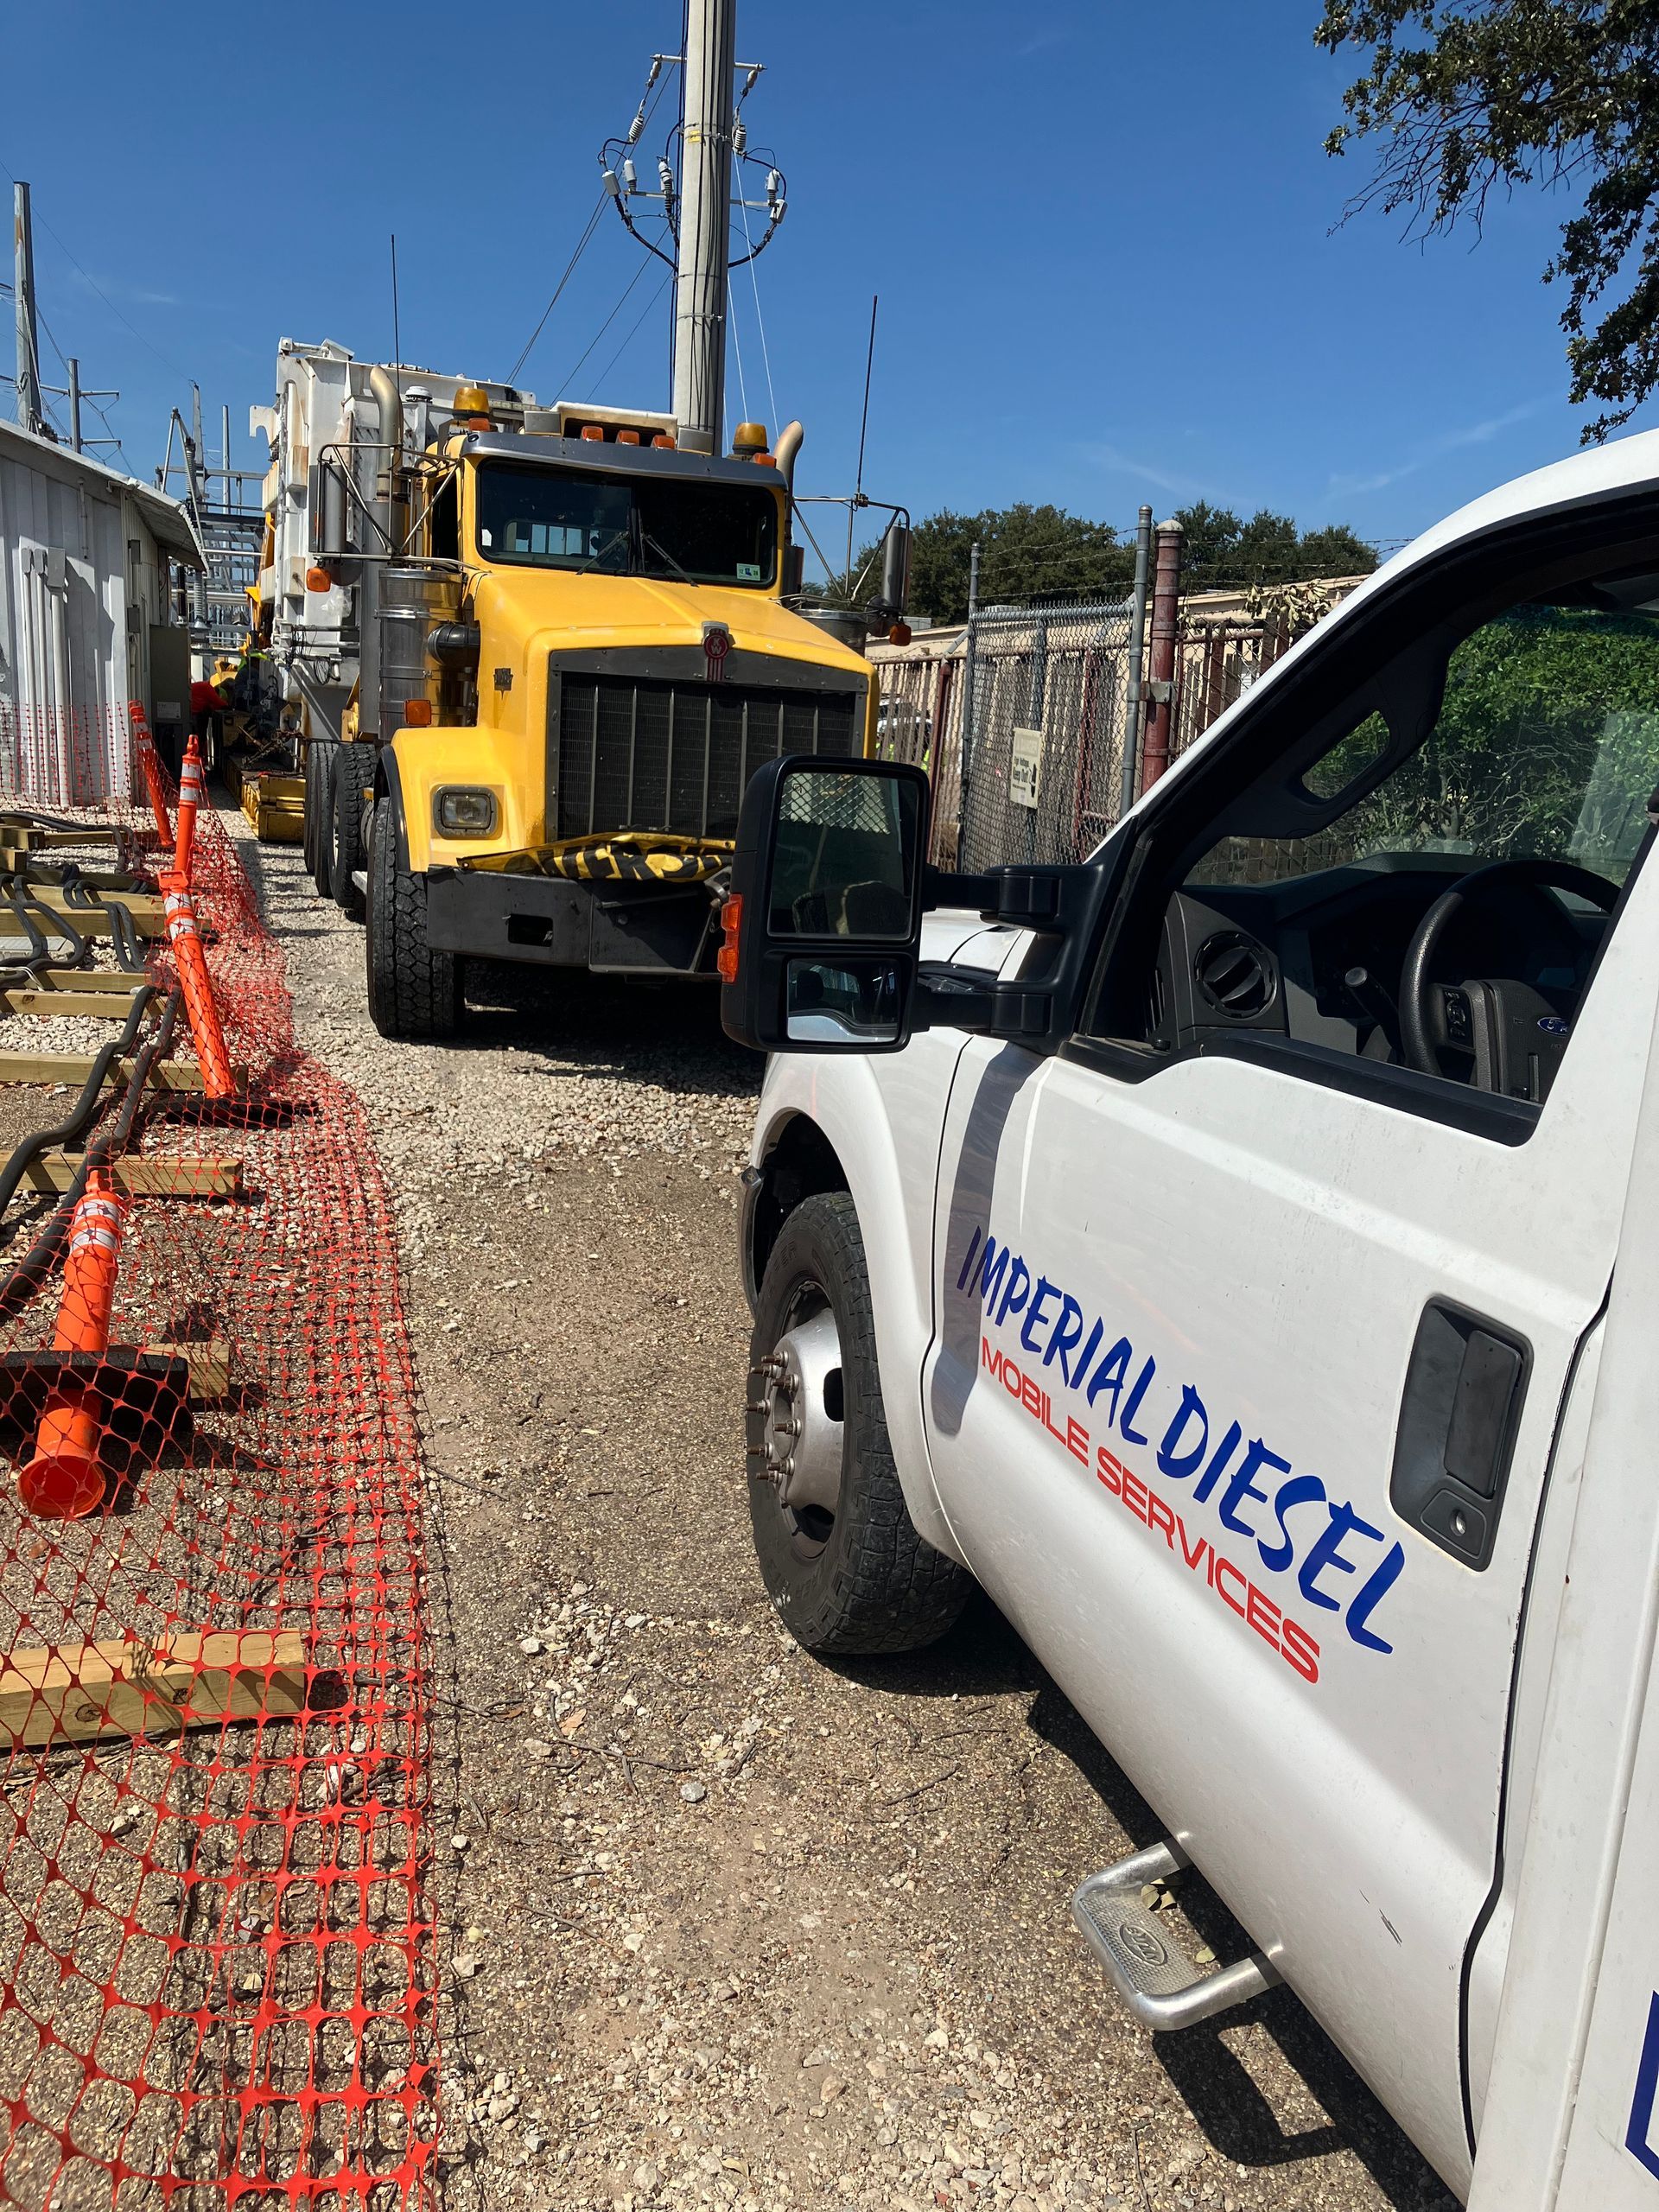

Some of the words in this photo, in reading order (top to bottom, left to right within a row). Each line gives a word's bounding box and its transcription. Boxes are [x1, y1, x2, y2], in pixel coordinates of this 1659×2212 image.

[956, 1225, 1156, 1446] IMPERIAL
[1156, 1384, 1405, 1655] DIESEL
[982, 1336, 1090, 1467] MOBILE
[1096, 1446, 1321, 1685] SERVICES
